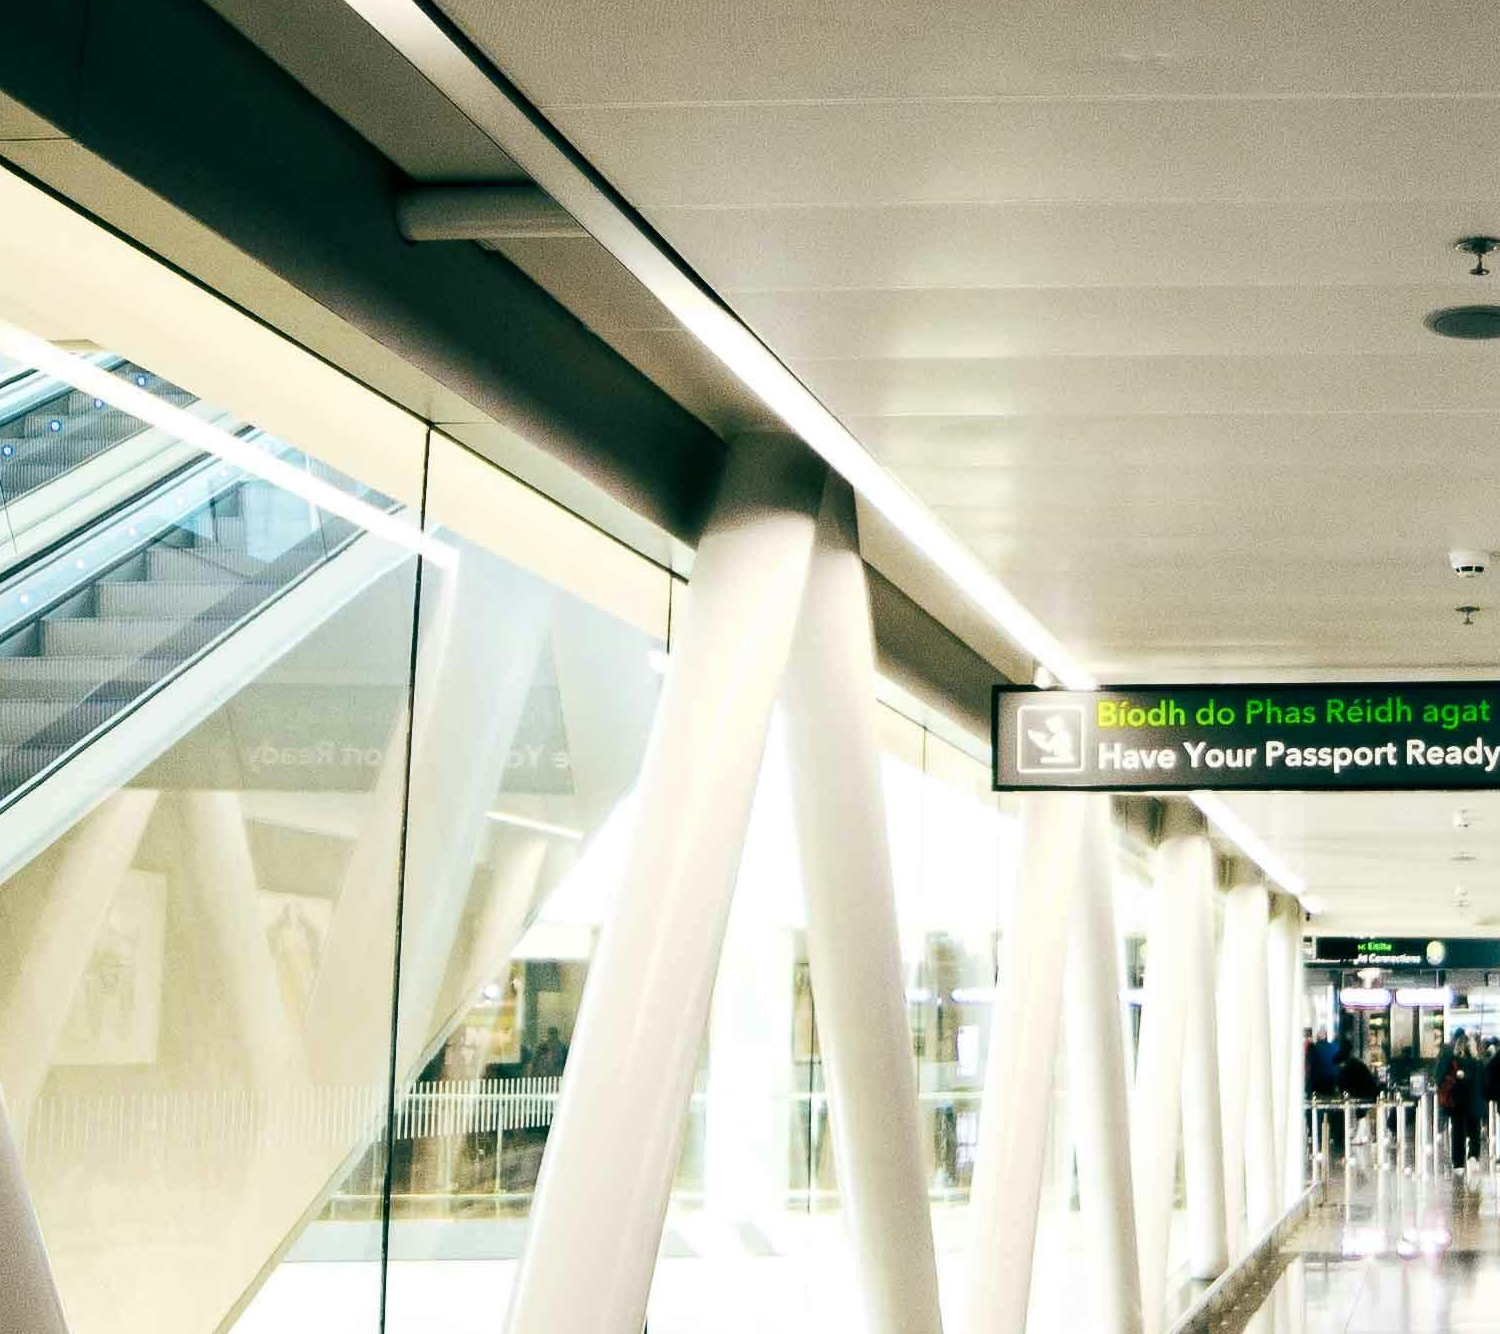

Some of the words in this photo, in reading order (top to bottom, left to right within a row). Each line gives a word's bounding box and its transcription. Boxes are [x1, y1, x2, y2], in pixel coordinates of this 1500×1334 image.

[1096, 700, 1185, 727] Bíodh
[1195, 700, 1236, 726] do
[1246, 699, 1316, 725] Phas
[1326, 696, 1412, 723] Réidh
[1422, 699, 1490, 728] agat
[1099, 742, 1175, 768] Have
[1184, 741, 1257, 768] Your
[1265, 741, 1396, 773] Passport
[1406, 738, 1500, 771] Ready
